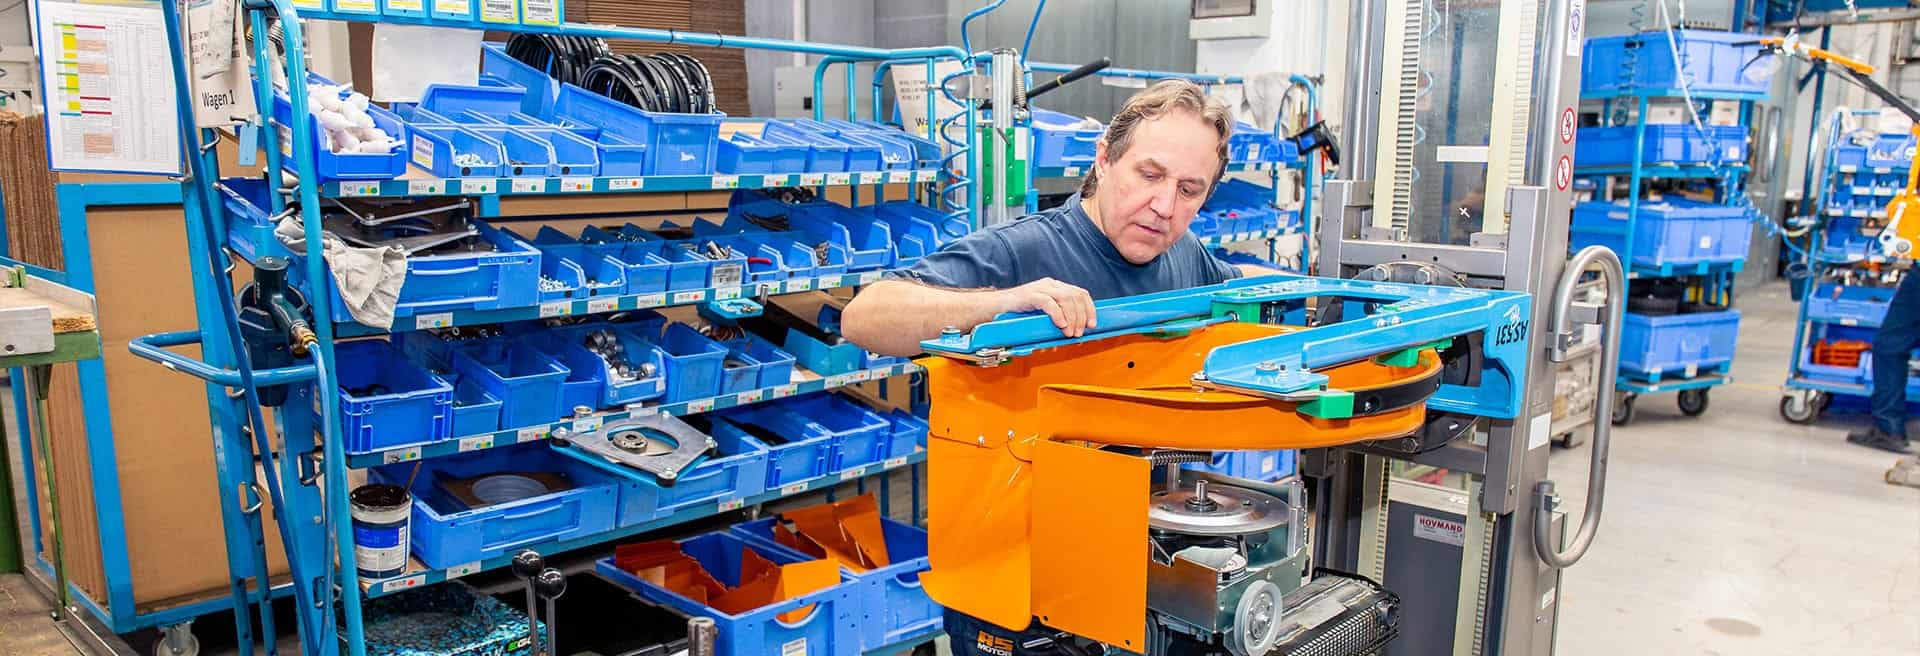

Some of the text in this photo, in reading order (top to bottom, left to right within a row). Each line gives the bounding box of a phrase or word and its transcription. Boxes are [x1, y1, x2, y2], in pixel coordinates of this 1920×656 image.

[201, 89, 235, 110] Wagen 1
[1419, 517, 1463, 532] HOVMAND
[977, 630, 1014, 652] AS
